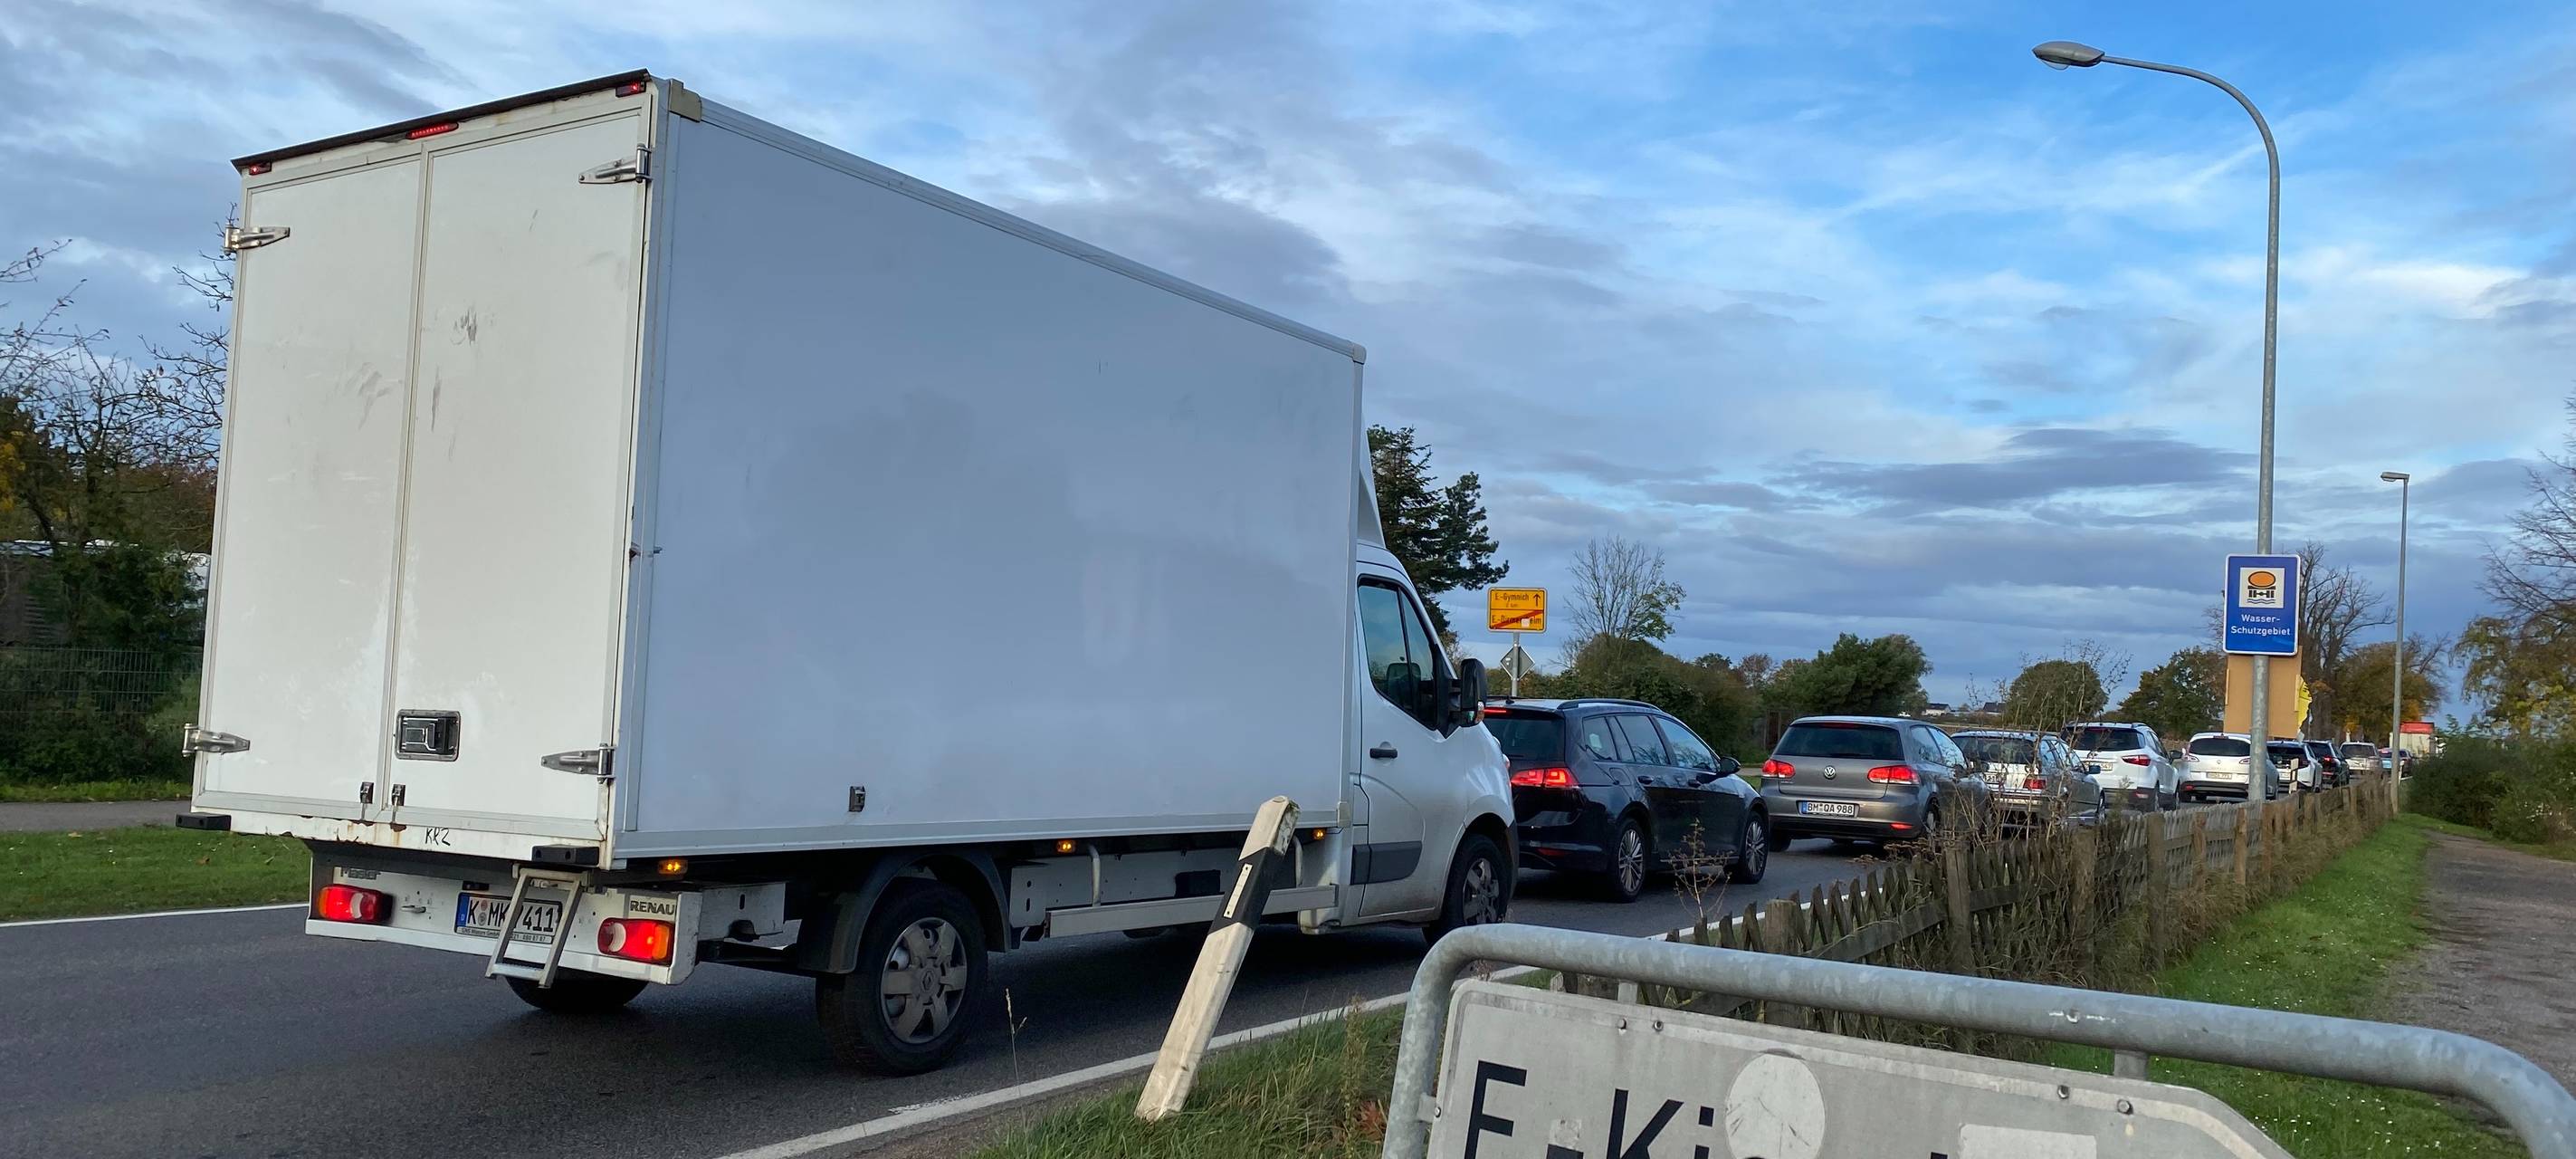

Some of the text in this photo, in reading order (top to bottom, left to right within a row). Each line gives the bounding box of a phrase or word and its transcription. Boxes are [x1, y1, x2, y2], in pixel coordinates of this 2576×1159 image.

[2240, 614, 2281, 623] Wasser-
[2230, 625, 2291, 637] Schutzgebiet
[1808, 802, 1853, 814] BM QA 988
[468, 900, 479, 924] K
